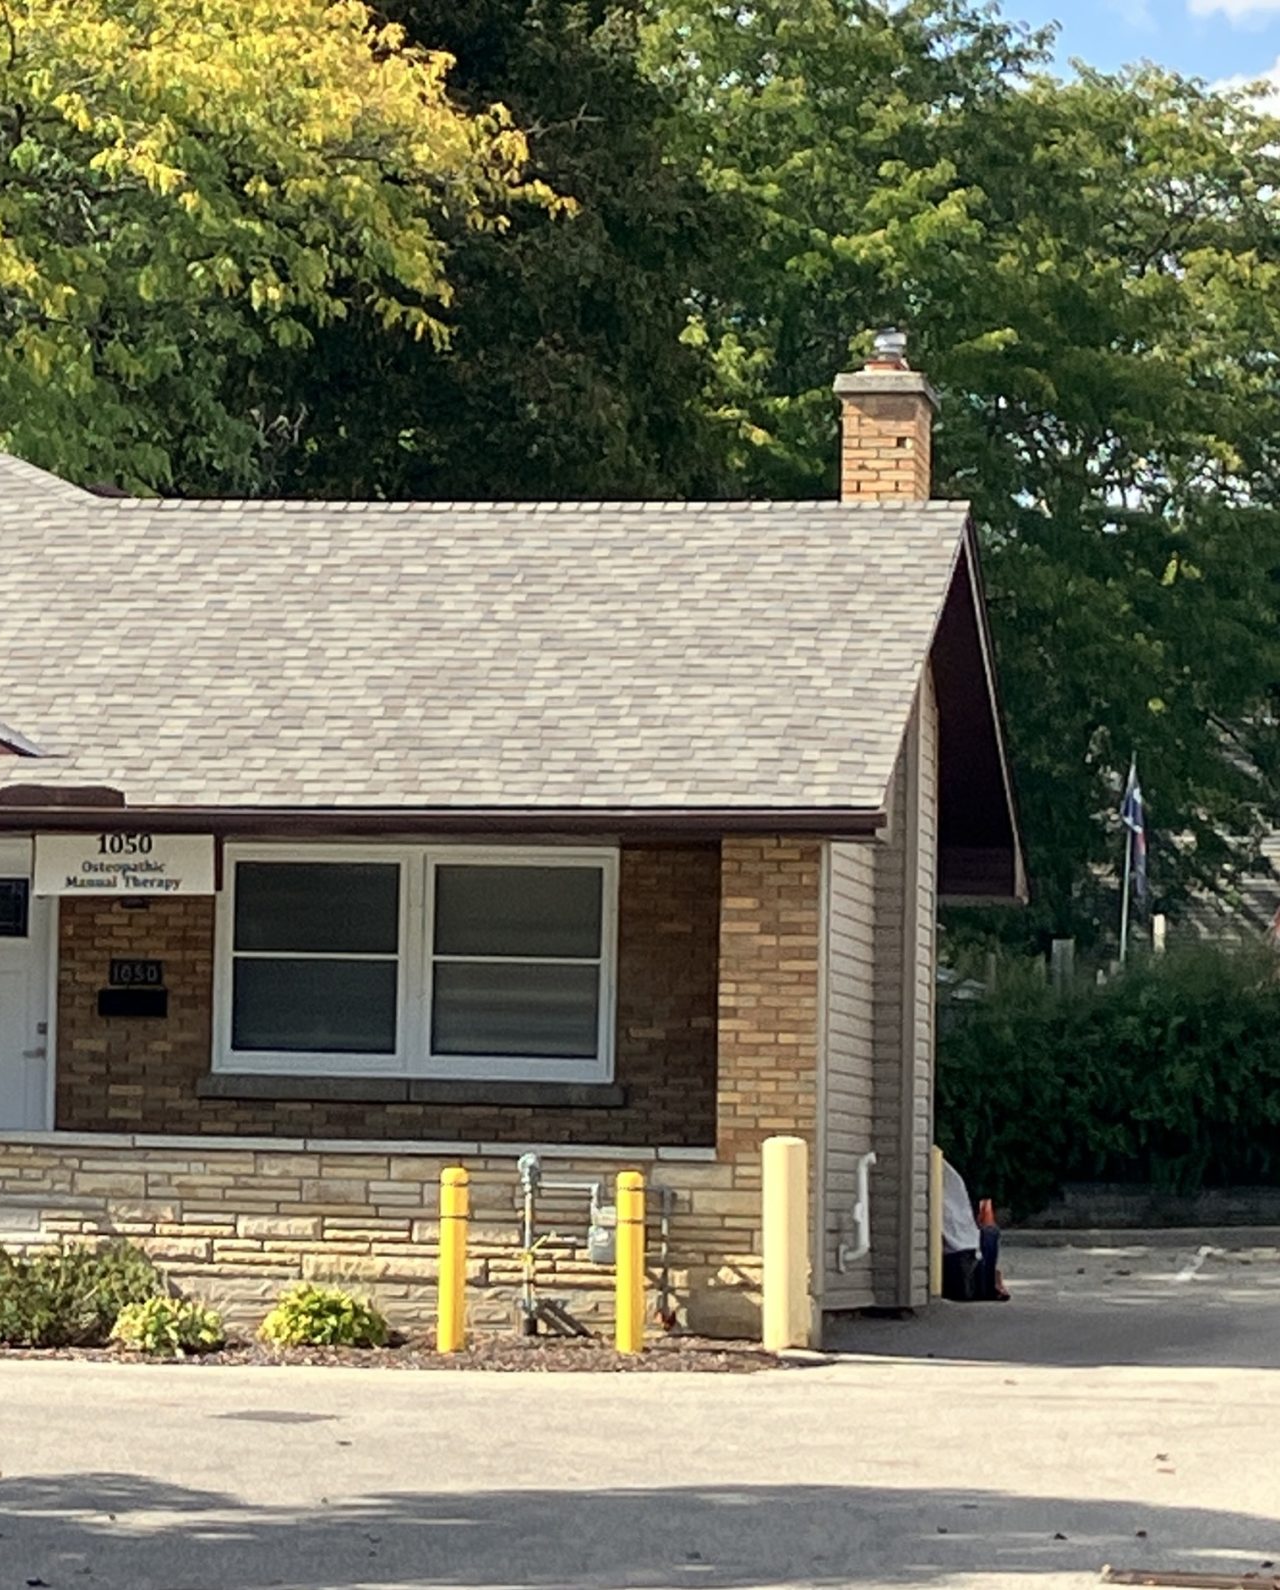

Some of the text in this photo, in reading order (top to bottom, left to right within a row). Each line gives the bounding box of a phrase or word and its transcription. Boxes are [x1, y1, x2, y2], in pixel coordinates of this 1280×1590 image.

[97, 833, 153, 854] 1050
[81, 860, 166, 877] Osteopathic
[65, 875, 183, 890] Manual Therapy
[113, 963, 158, 982] 1050
